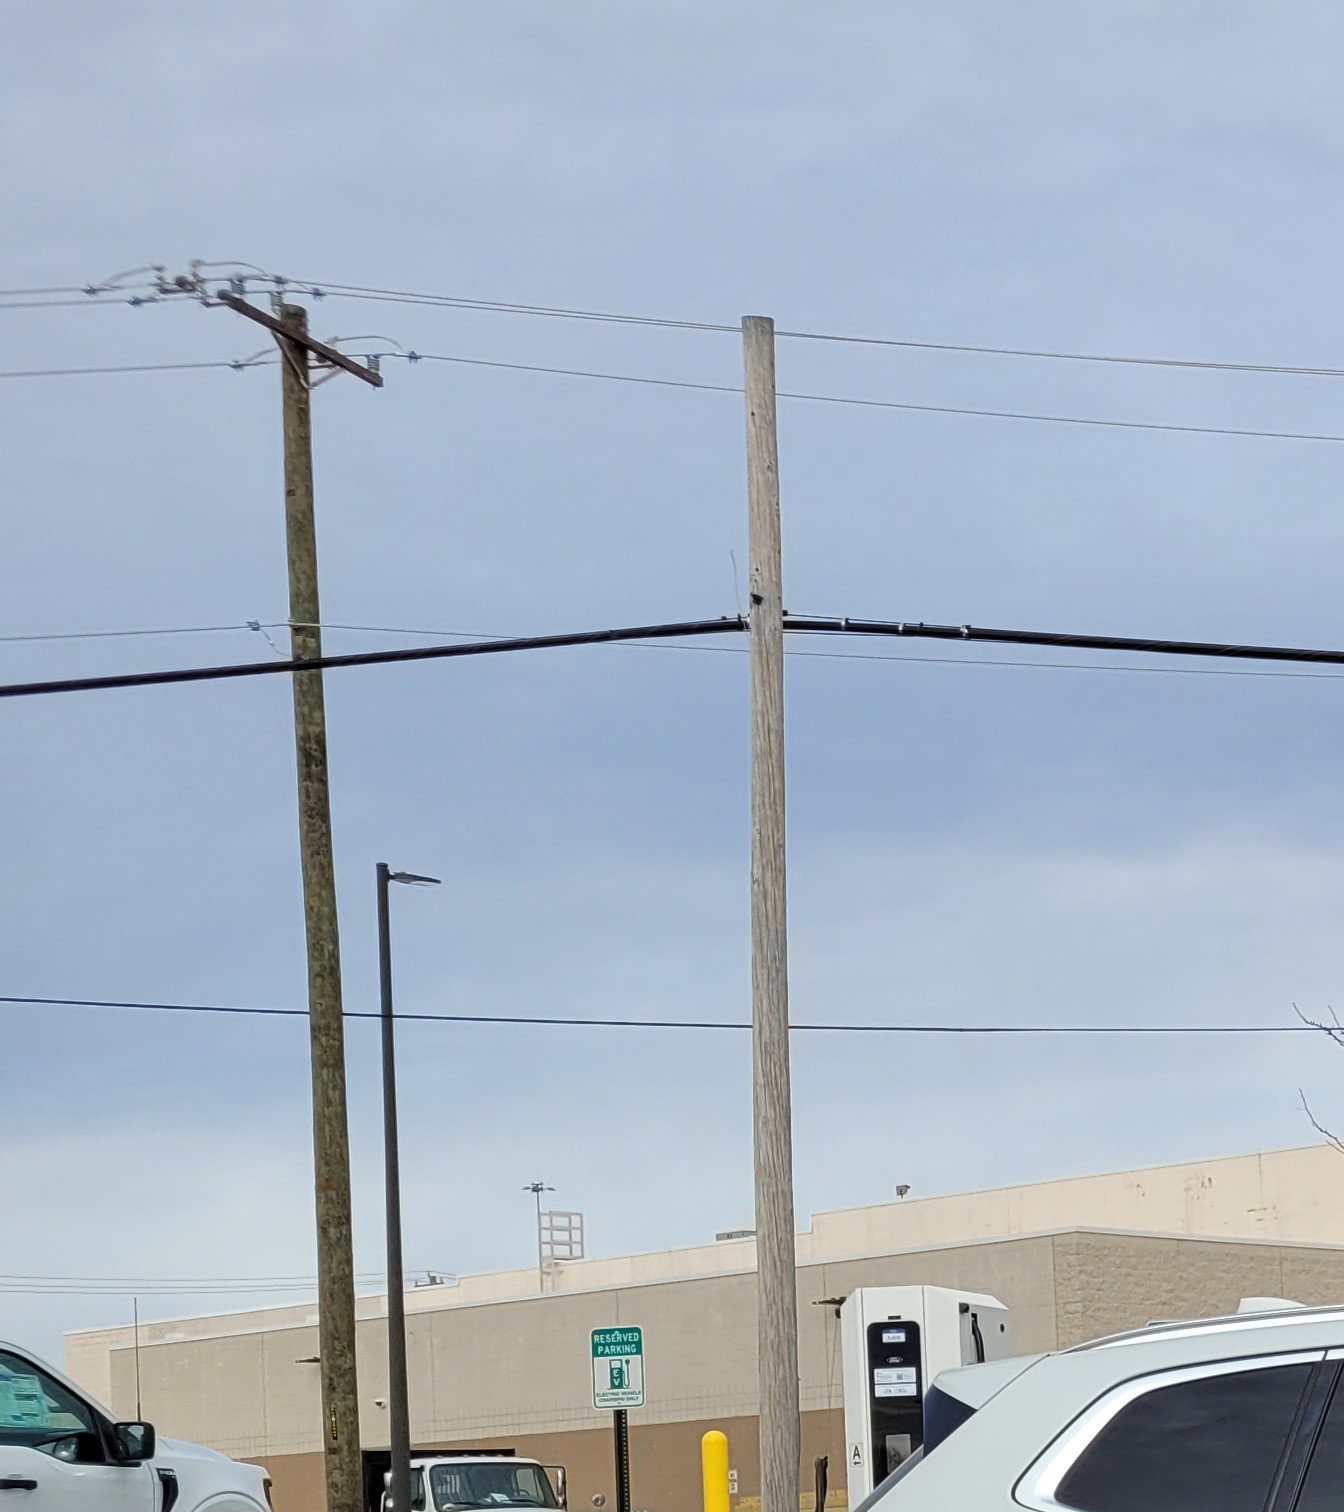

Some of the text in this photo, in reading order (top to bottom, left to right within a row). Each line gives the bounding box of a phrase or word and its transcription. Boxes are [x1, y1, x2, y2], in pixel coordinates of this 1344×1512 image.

[593, 1332, 640, 1344] RESERVED
[597, 1344, 637, 1355] PARKING
[853, 1445, 861, 1460] A
